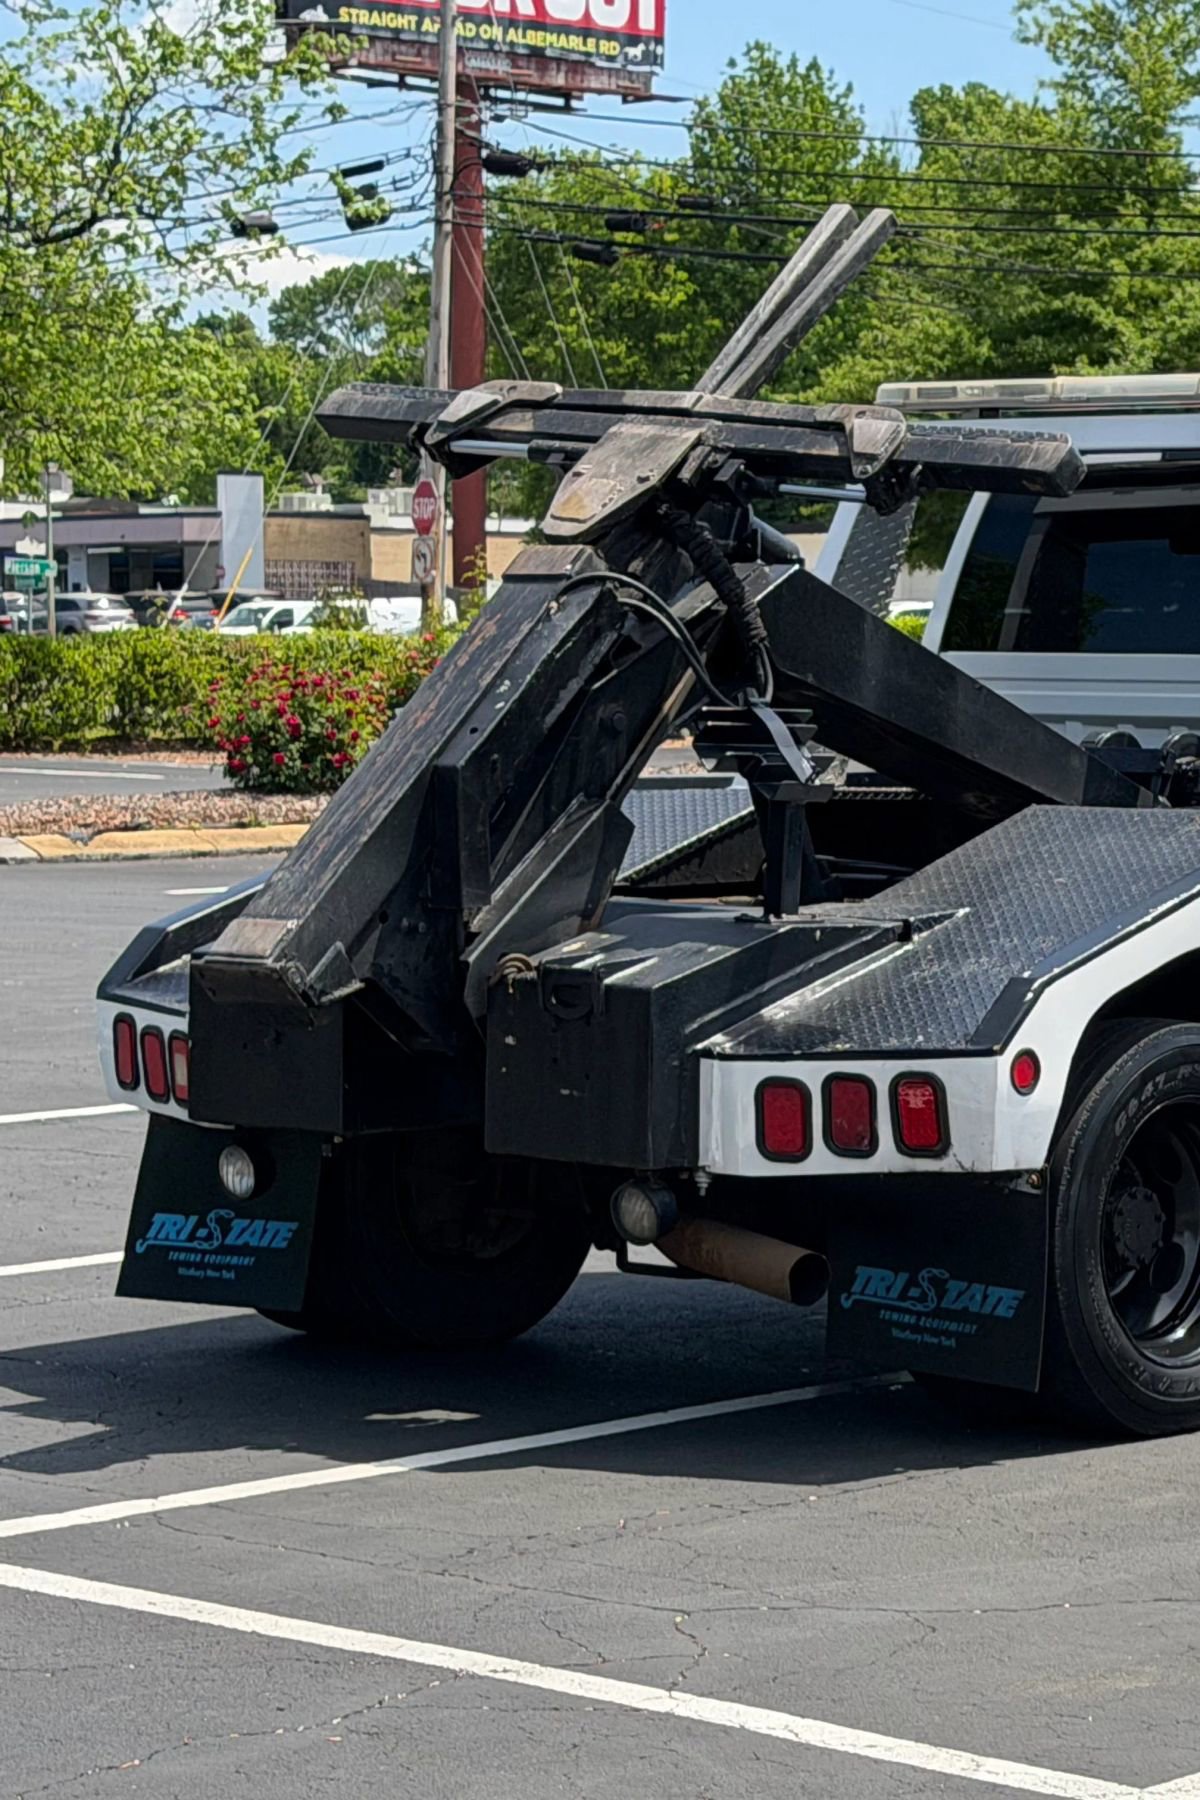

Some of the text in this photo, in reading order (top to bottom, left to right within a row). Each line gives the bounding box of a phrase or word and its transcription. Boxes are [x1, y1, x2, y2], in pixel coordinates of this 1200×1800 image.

[339, 6, 418, 32] STRAIGHT
[479, 23, 503, 41] ON
[506, 27, 597, 54] ALBEMARLE
[599, 40, 621, 56] RD
[414, 497, 436, 519] STOP
[145, 1209, 299, 1249] TRI-STATE
[168, 1250, 256, 1267] TOWING EQUIPMENT
[850, 1266, 1026, 1318] TRI-STATE
[879, 1309, 978, 1335] TOWING EQUIPMENT
